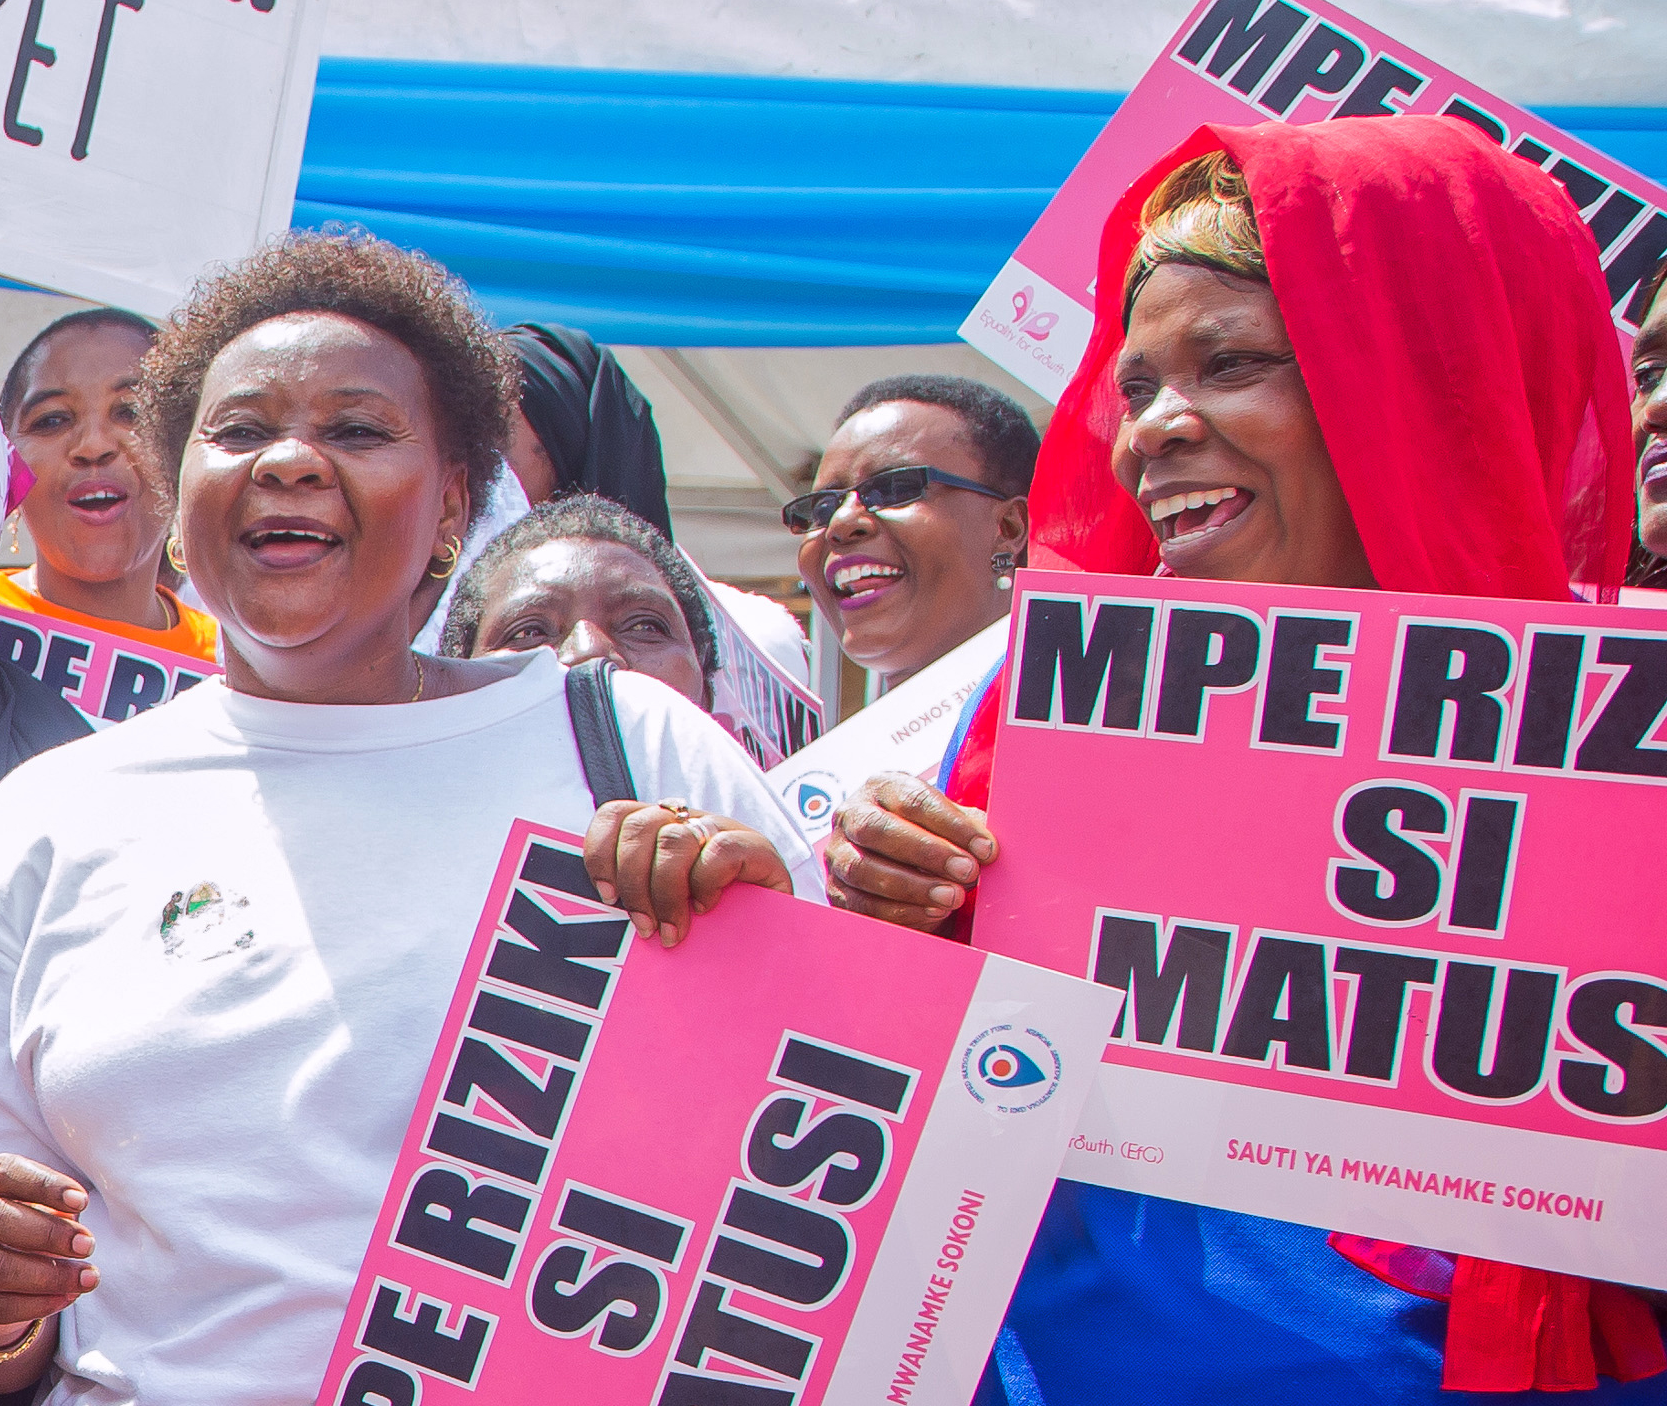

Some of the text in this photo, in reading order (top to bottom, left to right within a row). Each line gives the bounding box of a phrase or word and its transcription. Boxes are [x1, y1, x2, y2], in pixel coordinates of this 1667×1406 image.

[979, 309, 1016, 342] Equality
[1016, 335, 1031, 351] for
[1032, 346, 1065, 378] Growth
[891, 701, 952, 745] SOKONI
[1006, 591, 1362, 755] MPE
[1326, 777, 1528, 940] SI
[388, 832, 635, 1286] RIZIKI
[1120, 1141, 1164, 1165] (EfG)
[1227, 1138, 1604, 1222] SAUTI YA MWANAMKE SOKONI
[524, 1178, 697, 1360] SI
[887, 1274, 953, 1406] MWANAMKE
[936, 1189, 986, 1272] SOKONI
